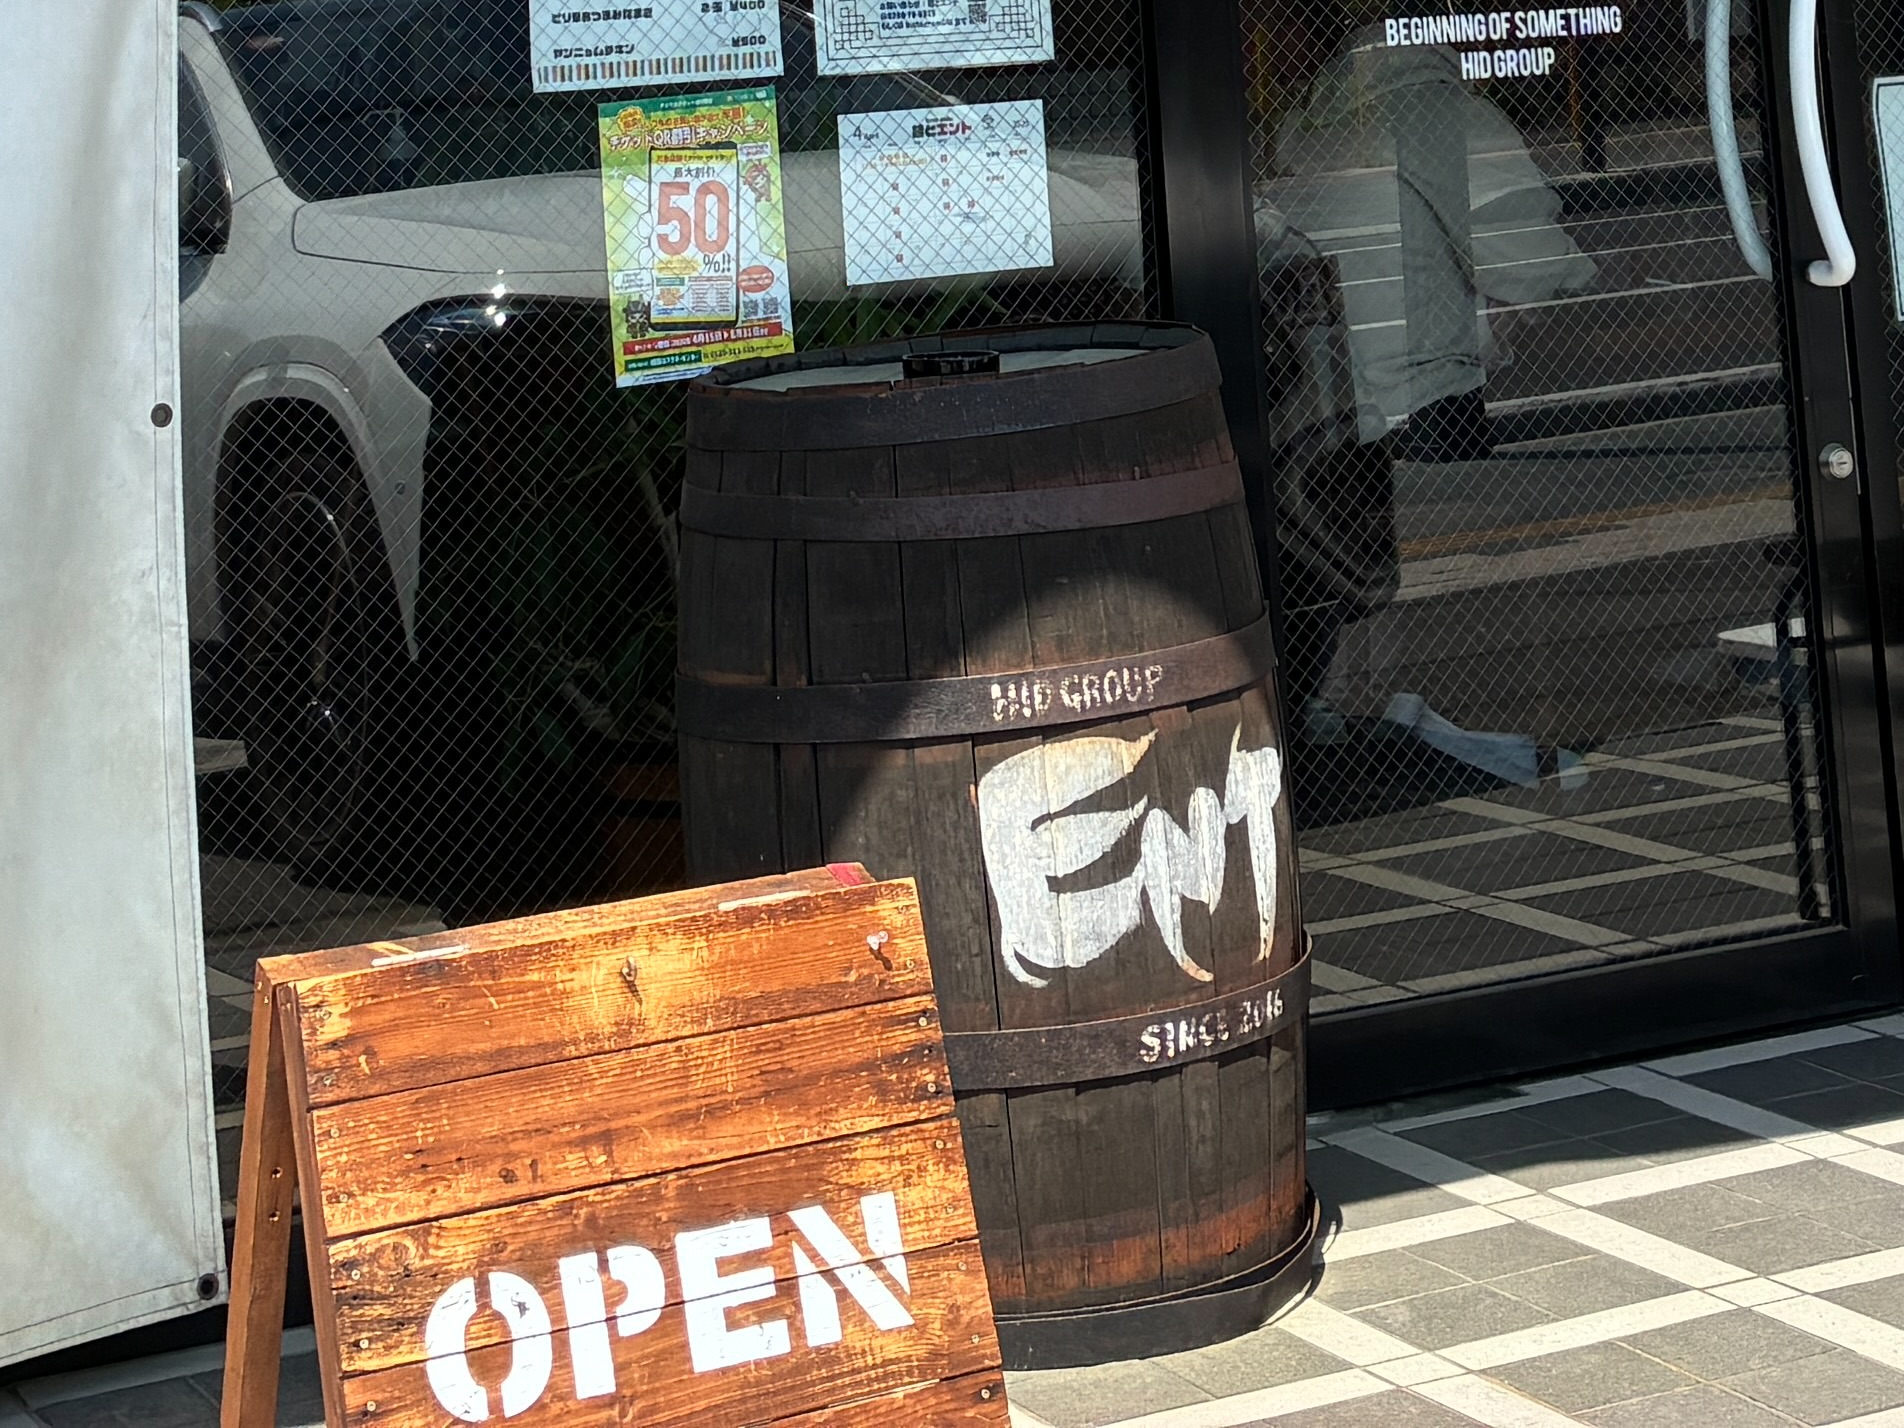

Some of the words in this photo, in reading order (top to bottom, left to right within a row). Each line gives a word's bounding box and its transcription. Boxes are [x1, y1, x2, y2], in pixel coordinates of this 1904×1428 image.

[1385, 14, 1486, 46] BEGINNING
[1489, 12, 1512, 40] OF
[1515, 5, 1623, 39] SOMETHING
[1461, 51, 1492, 81] HID
[1494, 47, 1556, 78] GROUP
[657, 180, 730, 256] 50
[1059, 664, 1165, 714] GROUP
[1139, 1012, 1231, 1064] SINCE
[1237, 988, 1285, 1036] 2016
[425, 1190, 916, 1424] OPEN
